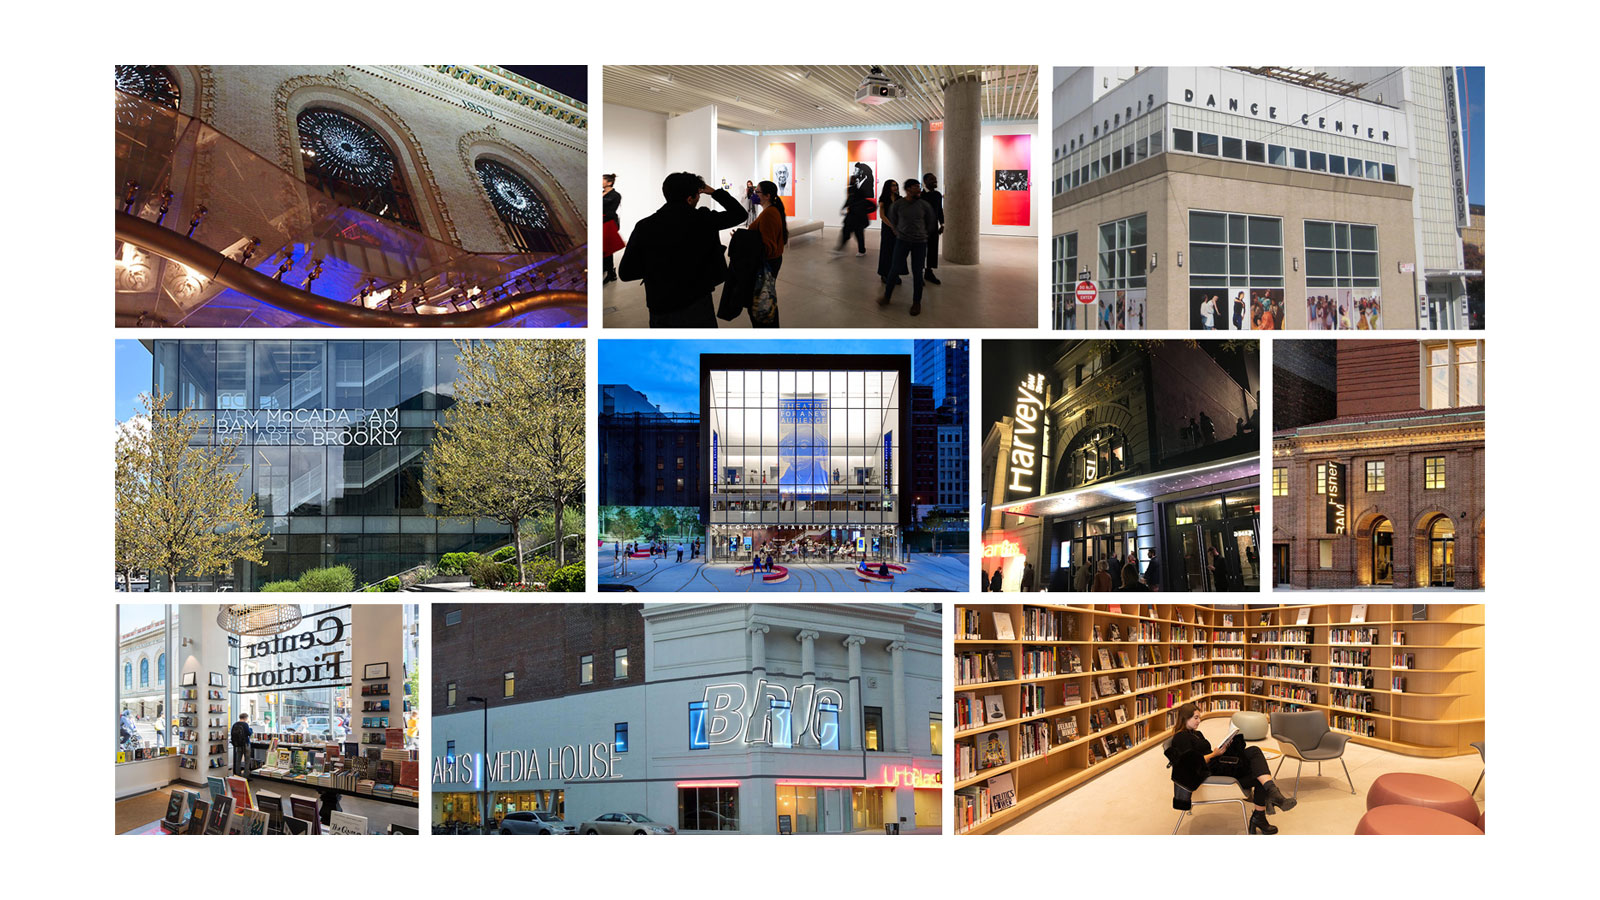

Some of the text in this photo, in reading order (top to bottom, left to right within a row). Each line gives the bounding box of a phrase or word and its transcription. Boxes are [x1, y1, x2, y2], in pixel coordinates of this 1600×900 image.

[1093, 94, 1154, 138] MORRIS
[1184, 89, 1390, 142] DANCE CENTER
[1446, 76, 1456, 124] MORRIS
[1451, 131, 1461, 171] DANCE
[1456, 179, 1465, 221] GROUP
[216, 419, 259, 434] BAM
[267, 408, 350, 423] MoCADA
[255, 431, 307, 446] ARTS
[313, 431, 402, 446] BROOKLY
[1009, 386, 1044, 492] Harvey
[694, 679, 843, 747] BRIC
[432, 742, 624, 785] ARTS MEDIA HOUSE
